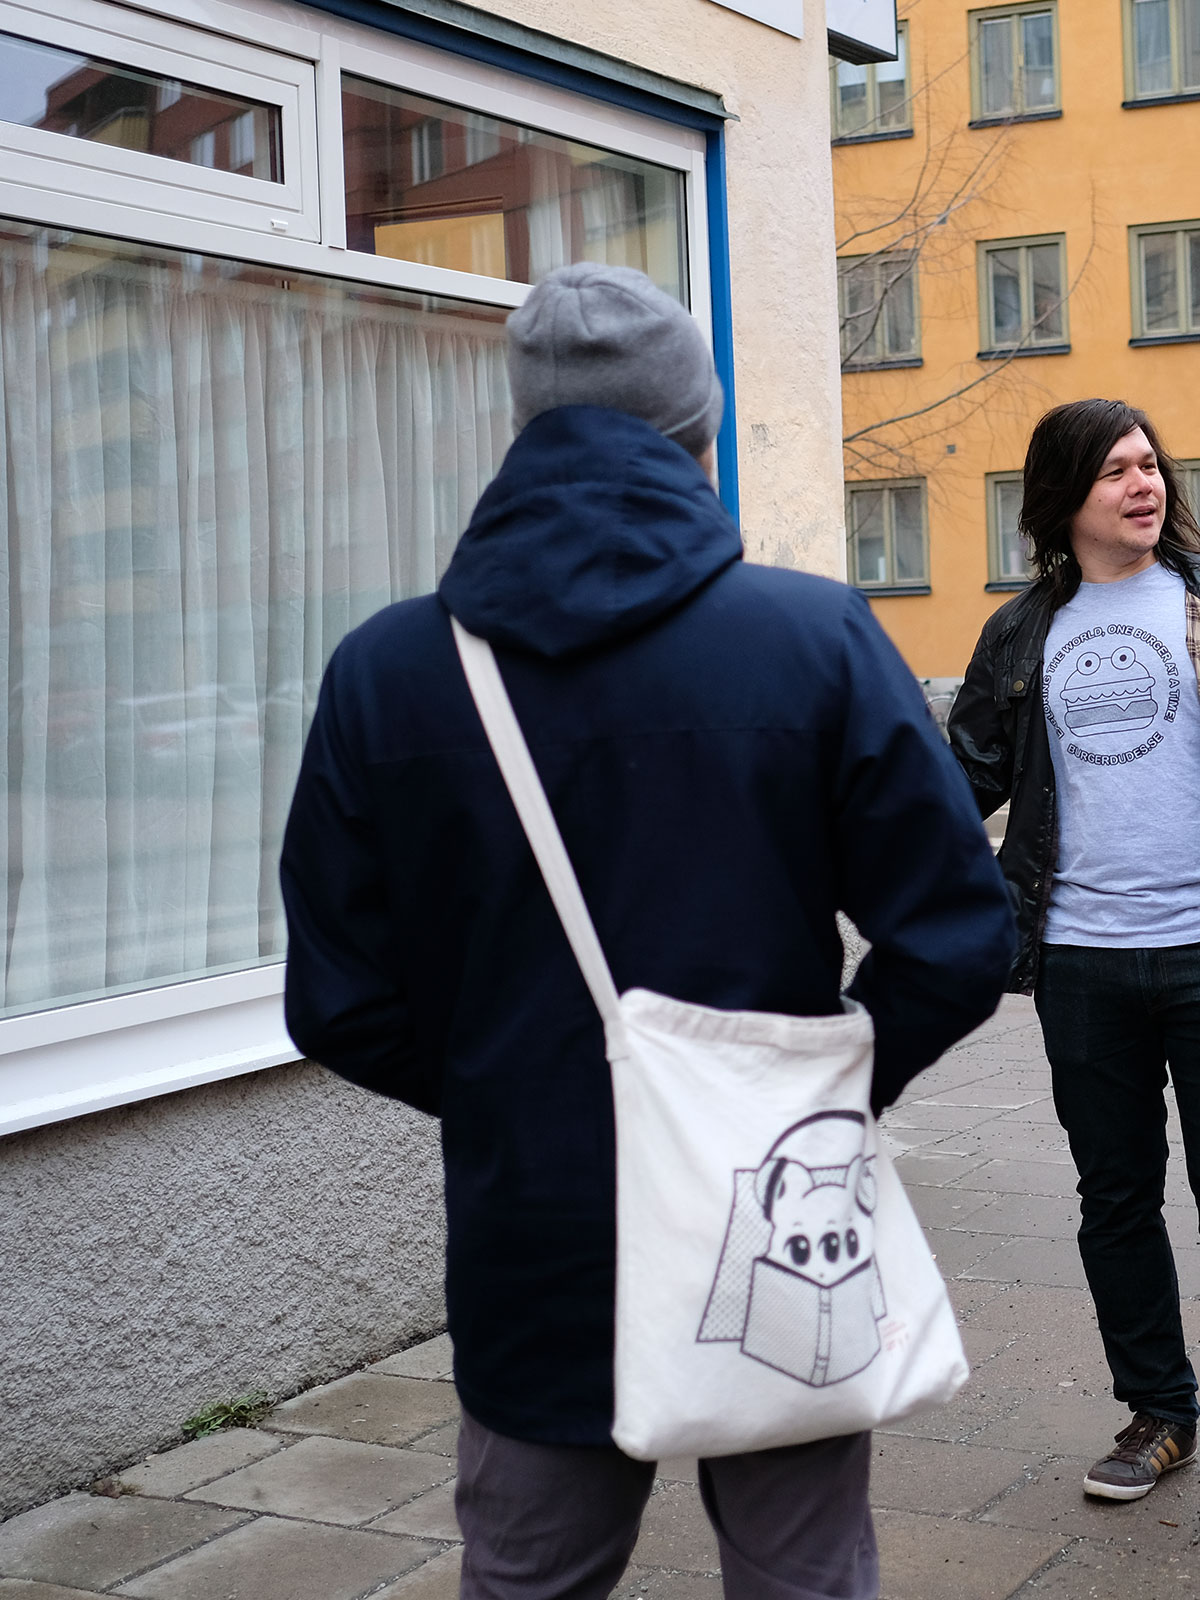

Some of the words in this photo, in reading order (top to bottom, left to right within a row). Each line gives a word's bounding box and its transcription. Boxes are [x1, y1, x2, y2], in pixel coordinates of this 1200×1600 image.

[1062, 626, 1106, 654] WORLD,
[1107, 624, 1134, 636] ONE
[1133, 628, 1172, 663] BURGER
[1046, 651, 1065, 674] THE
[1165, 663, 1179, 676] AT
[1169, 678, 1180, 688] A
[1163, 689, 1180, 723] TIME!
[1066, 731, 1165, 766] BURGERDUDES.SE
